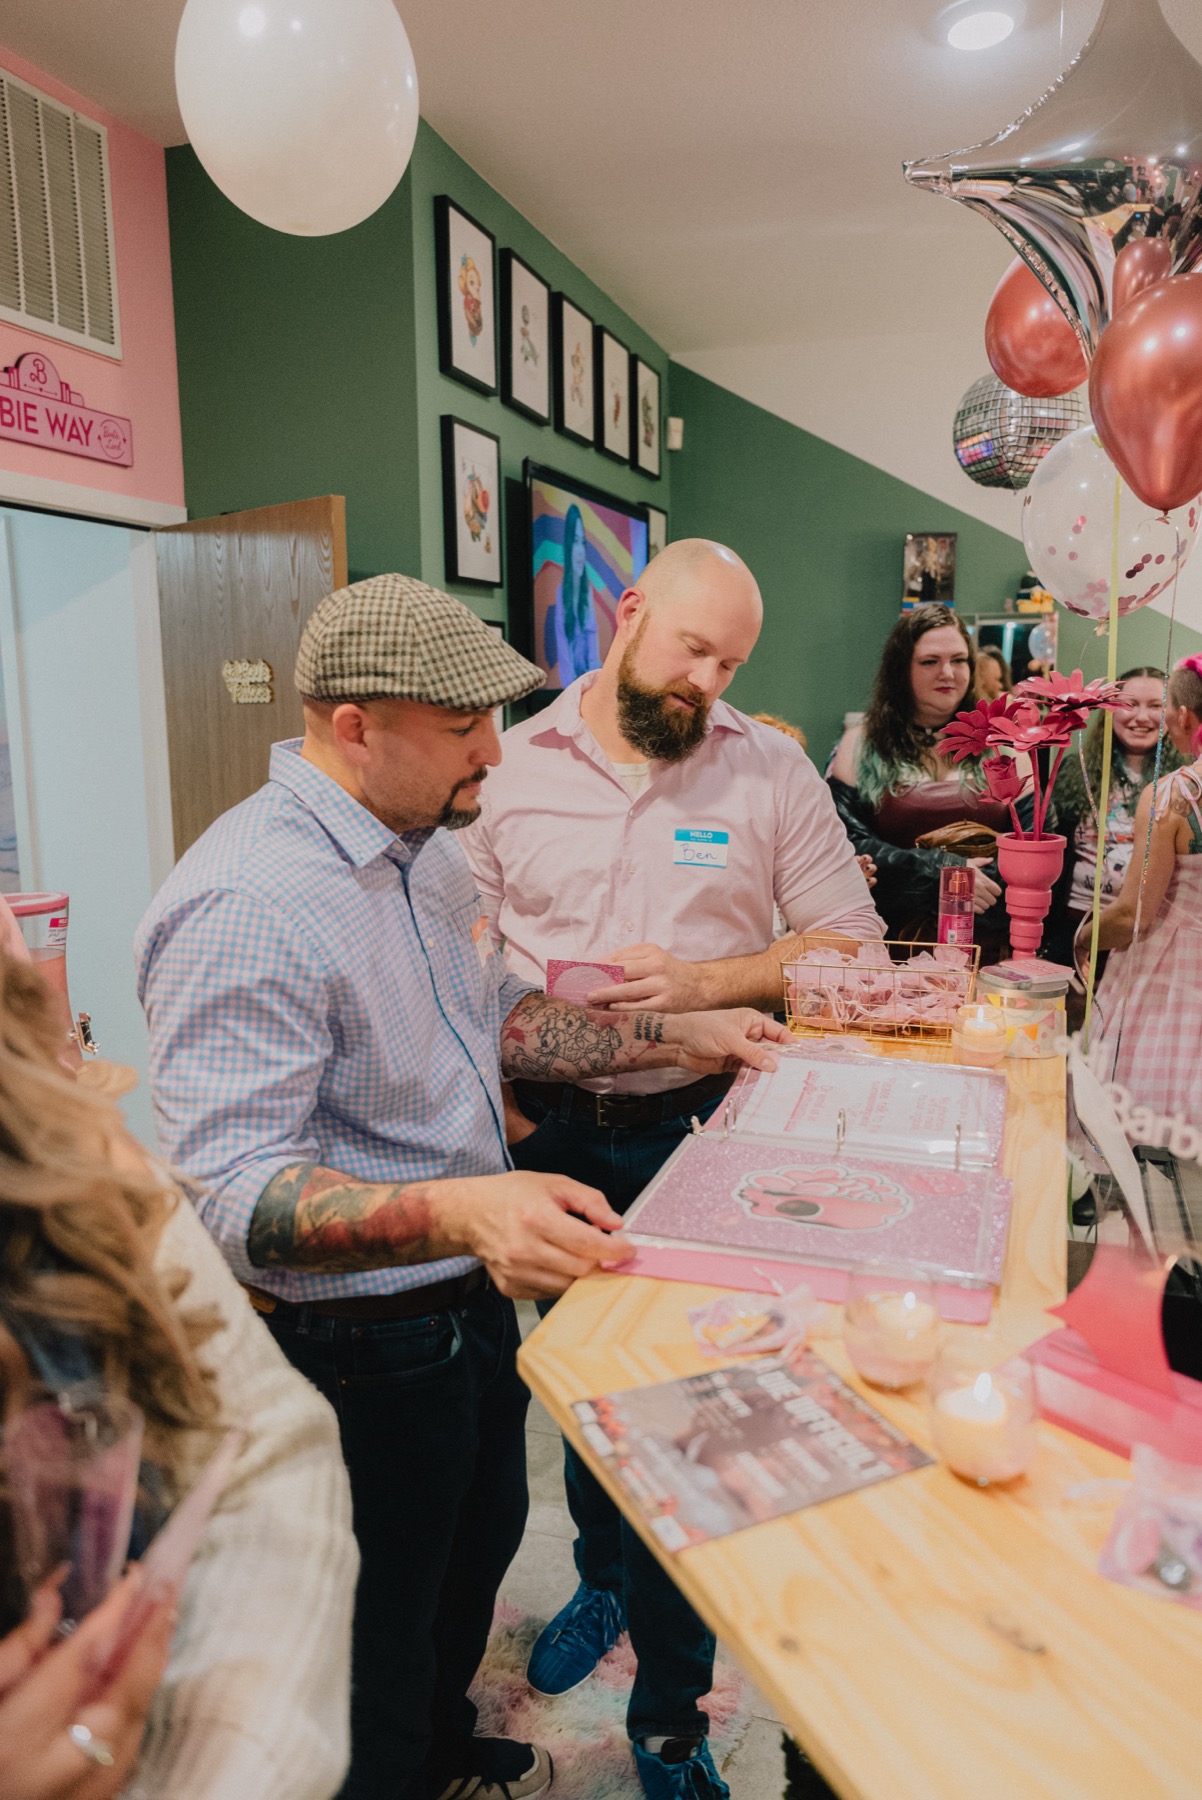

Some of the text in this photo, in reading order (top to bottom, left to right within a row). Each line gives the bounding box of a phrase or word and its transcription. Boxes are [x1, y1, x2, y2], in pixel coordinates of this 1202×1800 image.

[0, 396, 94, 446] BIE WAY
[680, 843, 718, 861] Ben
[690, 831, 713, 839] HELLO
[1100, 1082, 1202, 1165] Barb
